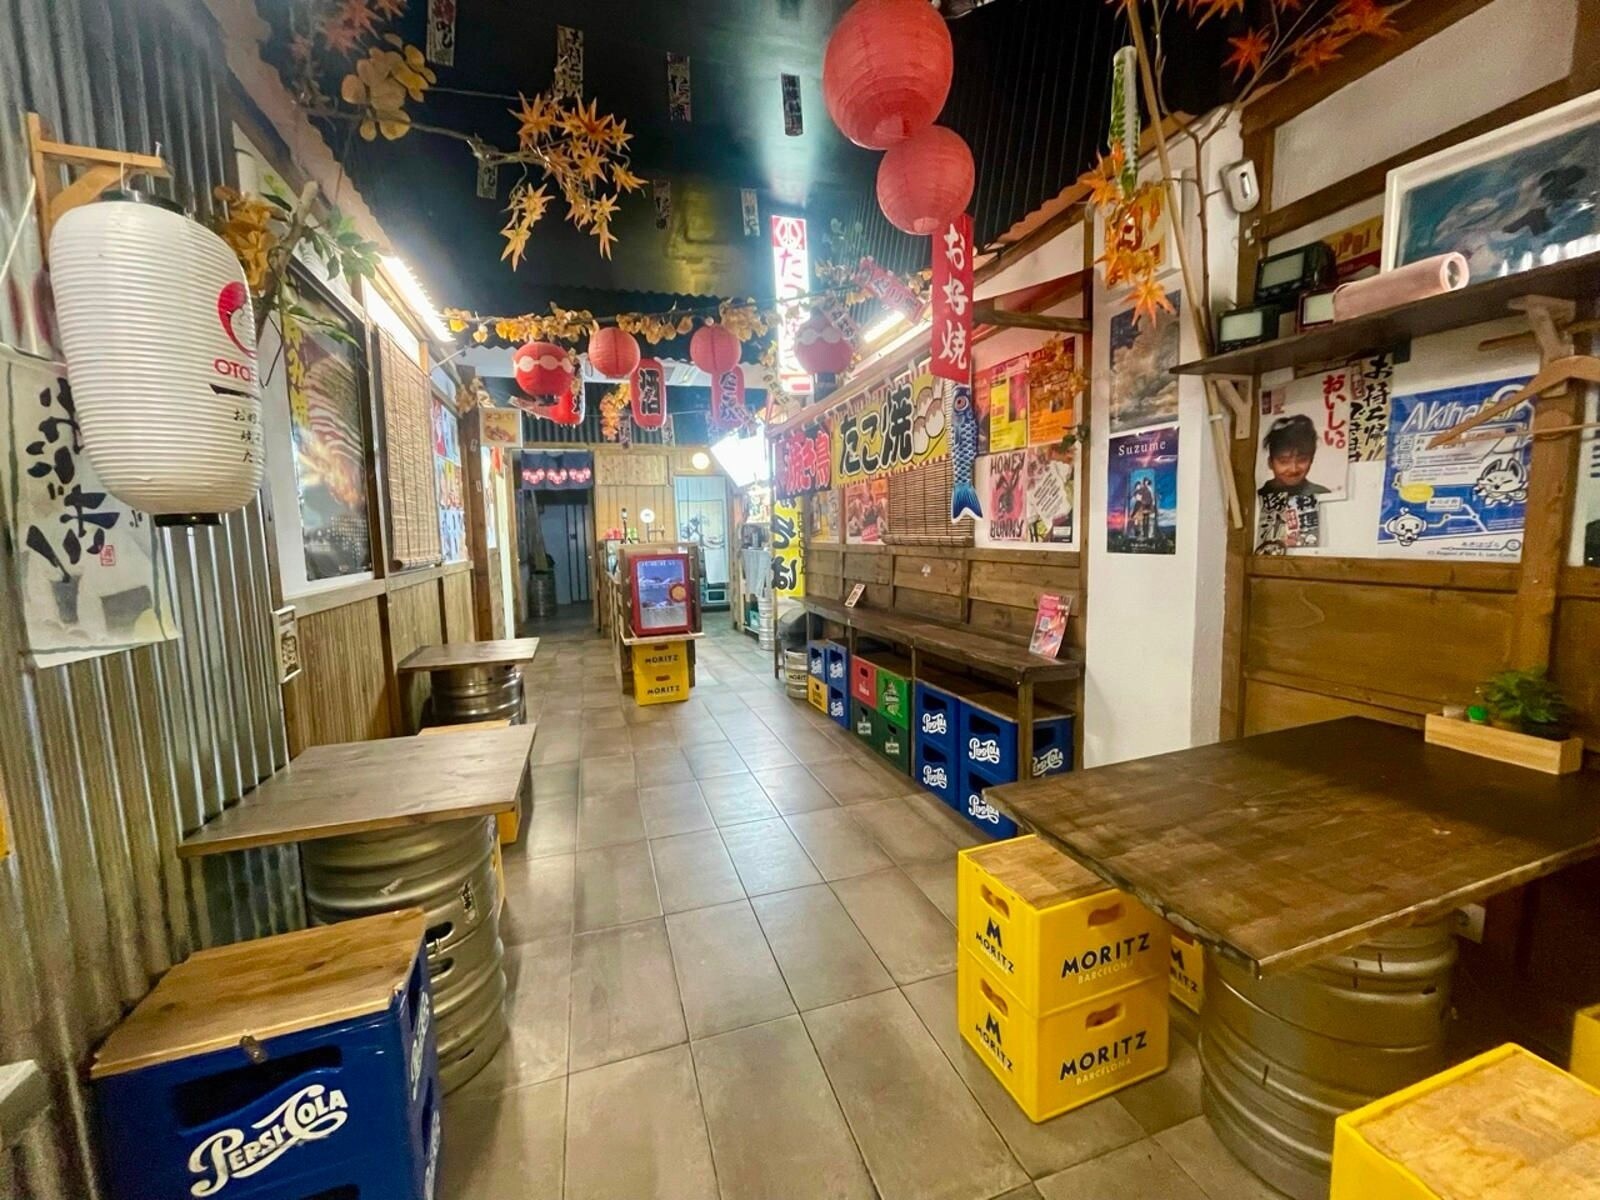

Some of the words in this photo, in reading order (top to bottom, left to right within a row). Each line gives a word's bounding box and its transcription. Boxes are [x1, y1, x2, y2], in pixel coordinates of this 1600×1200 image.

[1118, 440, 1167, 457] Suzume
[990, 453, 1026, 476] HONEY
[990, 519, 1025, 539] BUNNY
[645, 654, 679, 664] MORITZ
[975, 930, 1015, 975] MORITZ
[1061, 933, 1150, 978] MORITZ
[975, 1022, 1014, 1073] MORITZ
[1060, 1030, 1147, 1081] MORITZ
[1076, 1058, 1132, 1086] BARCELONA
